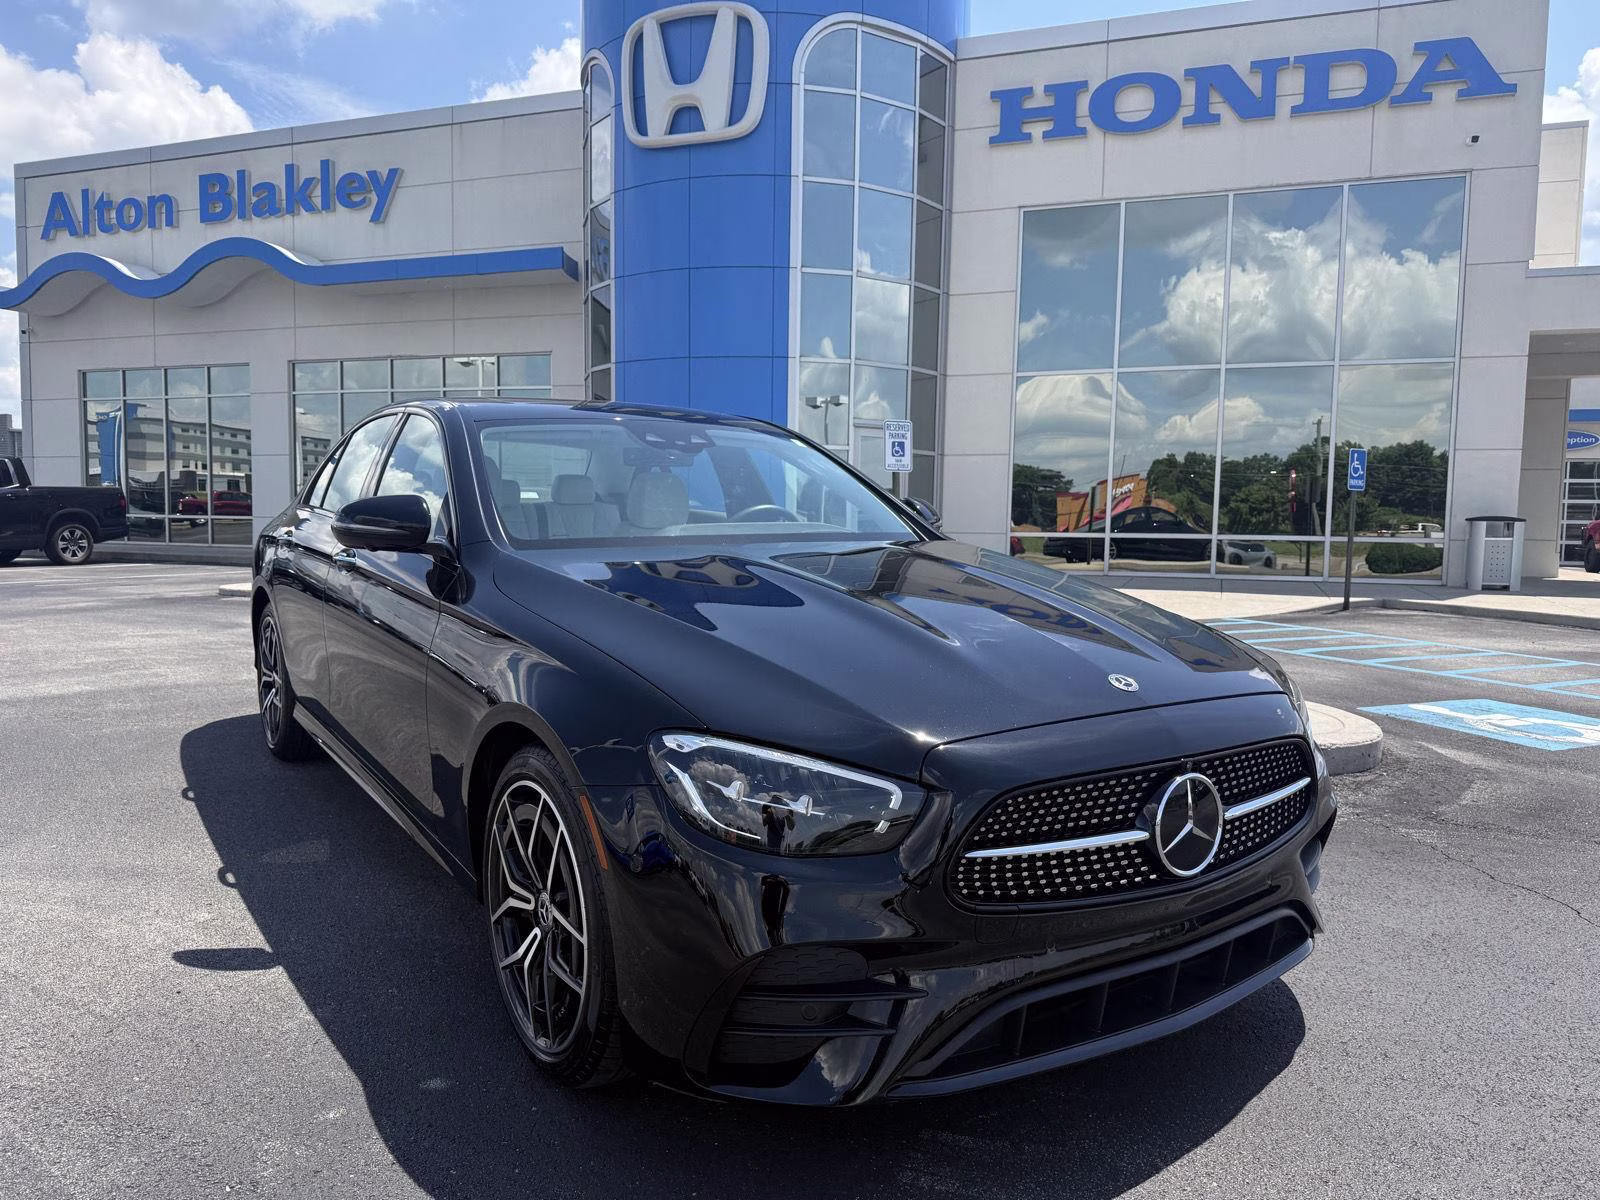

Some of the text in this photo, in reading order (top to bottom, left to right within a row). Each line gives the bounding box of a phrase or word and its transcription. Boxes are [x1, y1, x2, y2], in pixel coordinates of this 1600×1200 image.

[988, 36, 1517, 145] HONDA
[40, 158, 403, 241] Alton Blakley
[886, 423, 909, 432] RESERVED
[888, 432, 908, 440] PARKING
